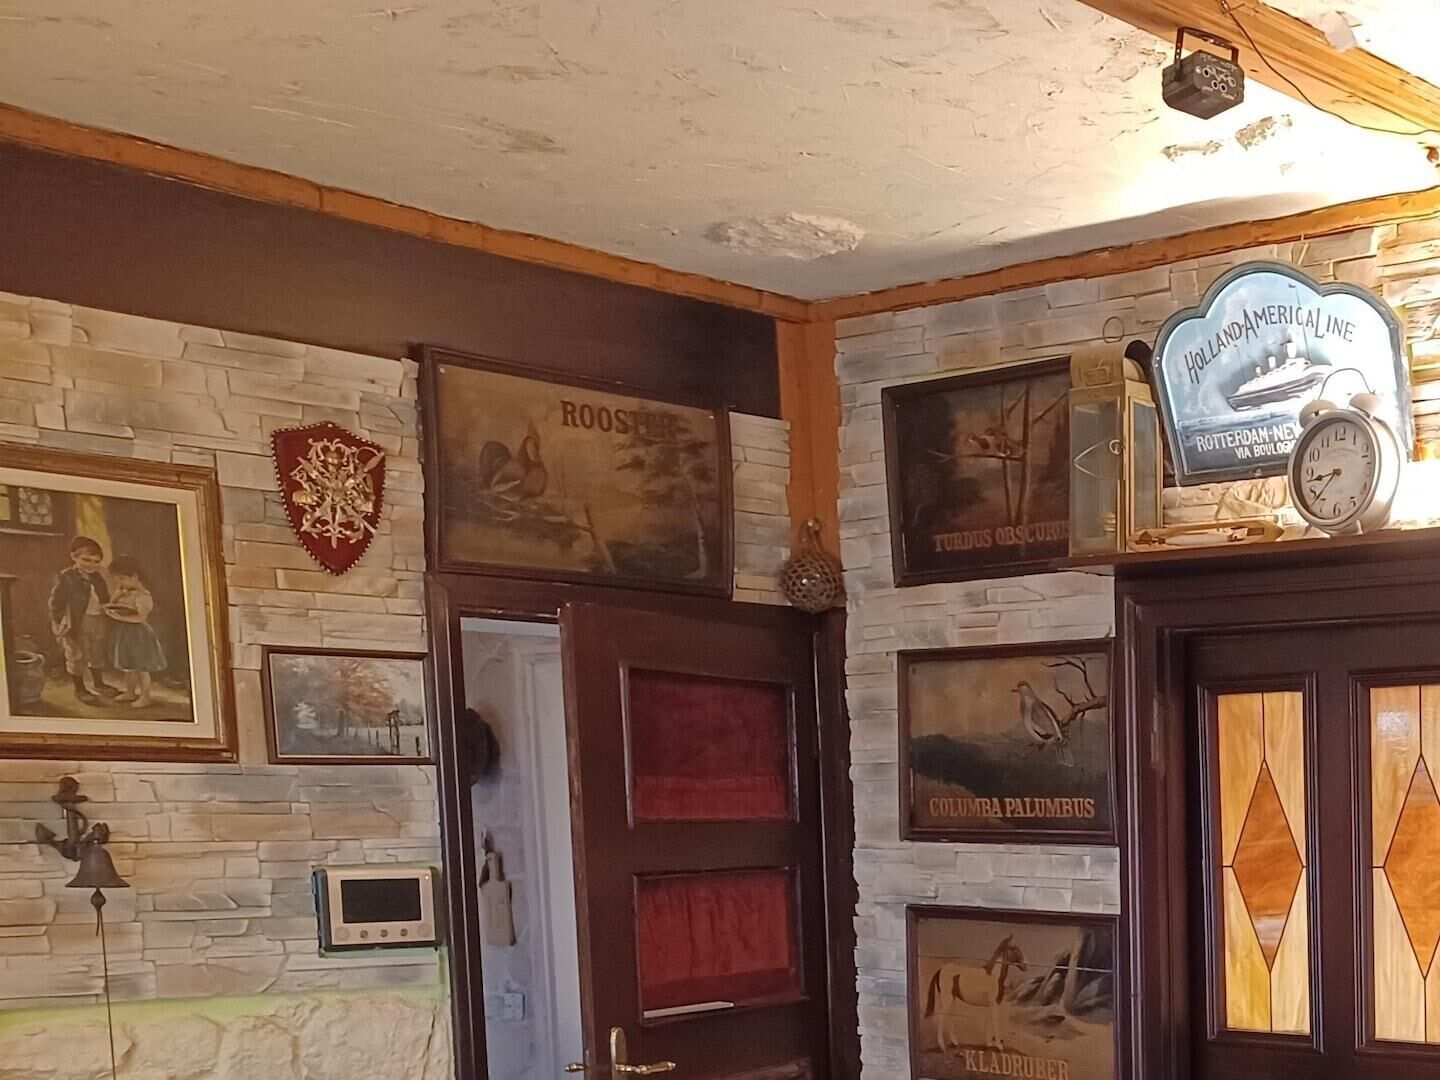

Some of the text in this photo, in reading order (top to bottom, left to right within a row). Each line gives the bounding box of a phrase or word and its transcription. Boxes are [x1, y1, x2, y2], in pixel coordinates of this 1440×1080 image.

[1313, 307, 1356, 343] LINE
[1334, 426, 1346, 441] 12
[1235, 446, 1252, 459] VIA
[1309, 448, 1320, 462] 10
[1333, 502, 1341, 517] 6
[933, 528, 993, 553] TURDUS
[930, 798, 1095, 818] COLUMBA PALUMBUS
